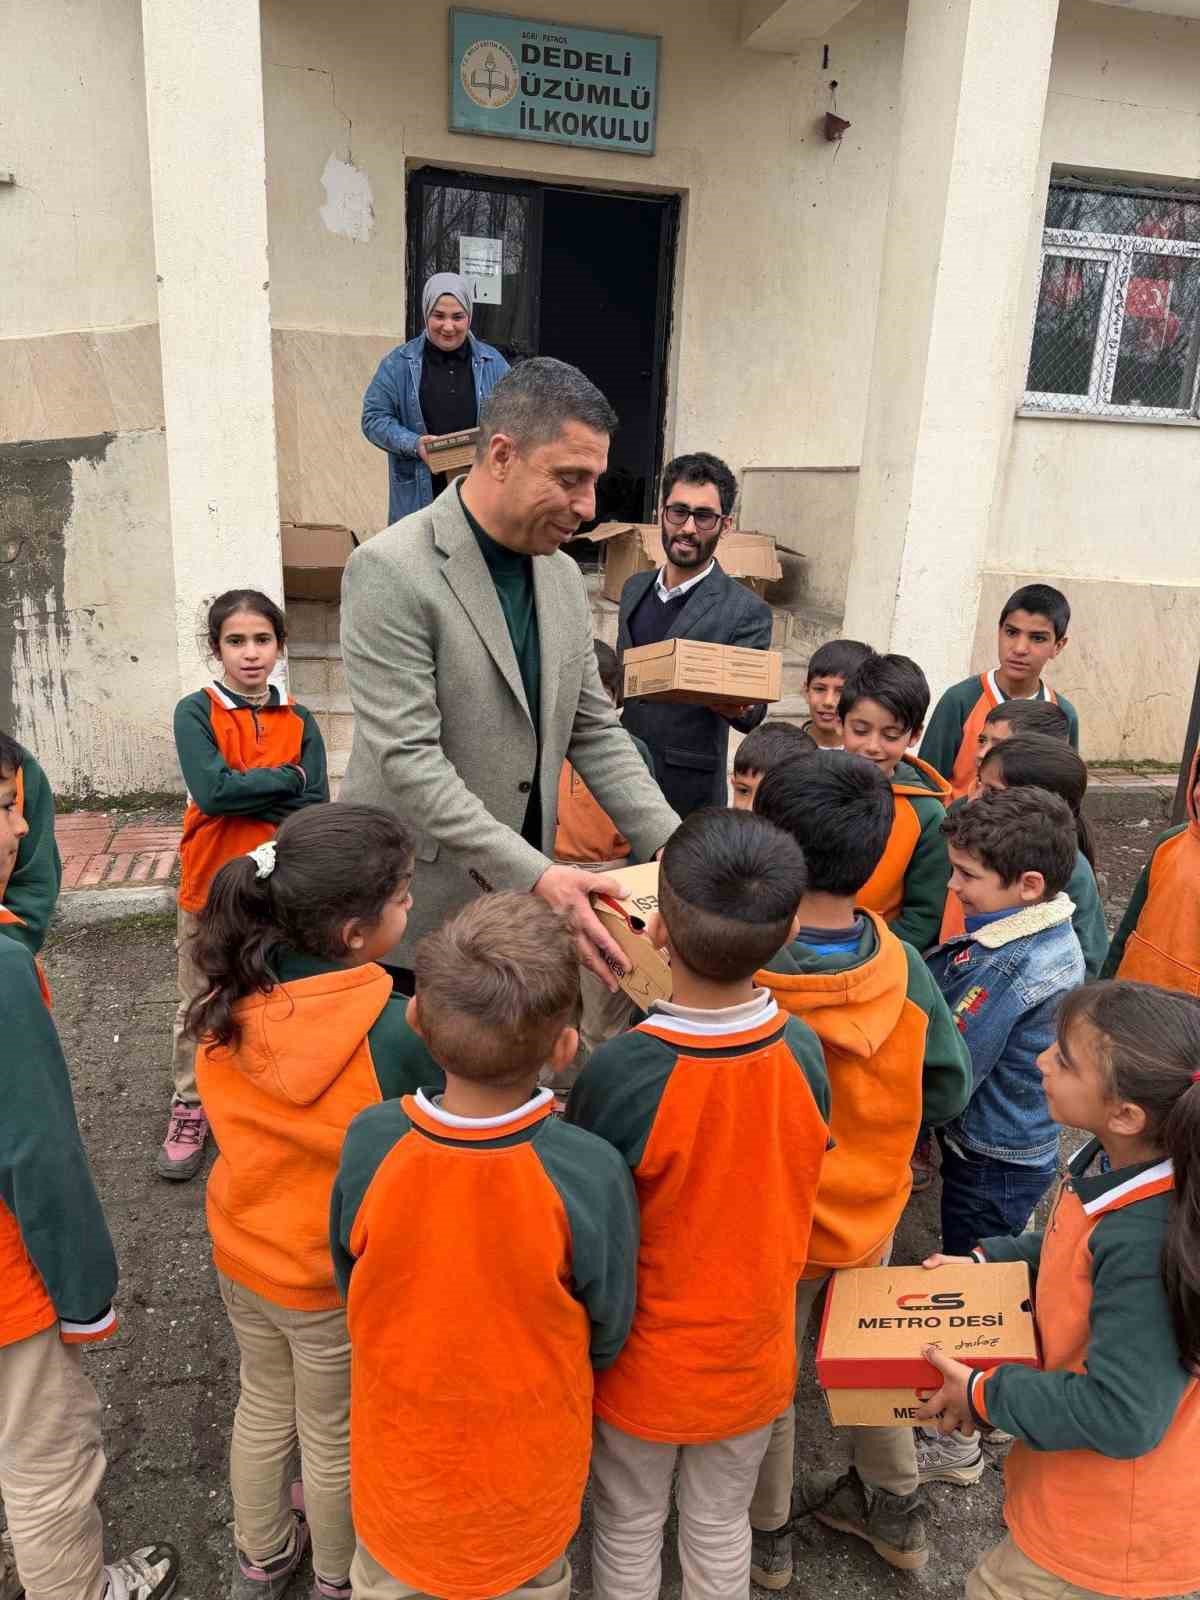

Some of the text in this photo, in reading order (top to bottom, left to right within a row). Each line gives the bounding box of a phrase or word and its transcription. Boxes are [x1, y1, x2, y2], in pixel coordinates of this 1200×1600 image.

[520, 43, 632, 77] DEDELİ
[520, 71, 650, 110] ÜZÜMLÜ
[519, 100, 650, 144] İLKOKULU
[857, 1312, 1004, 1329] METRO DESİ
